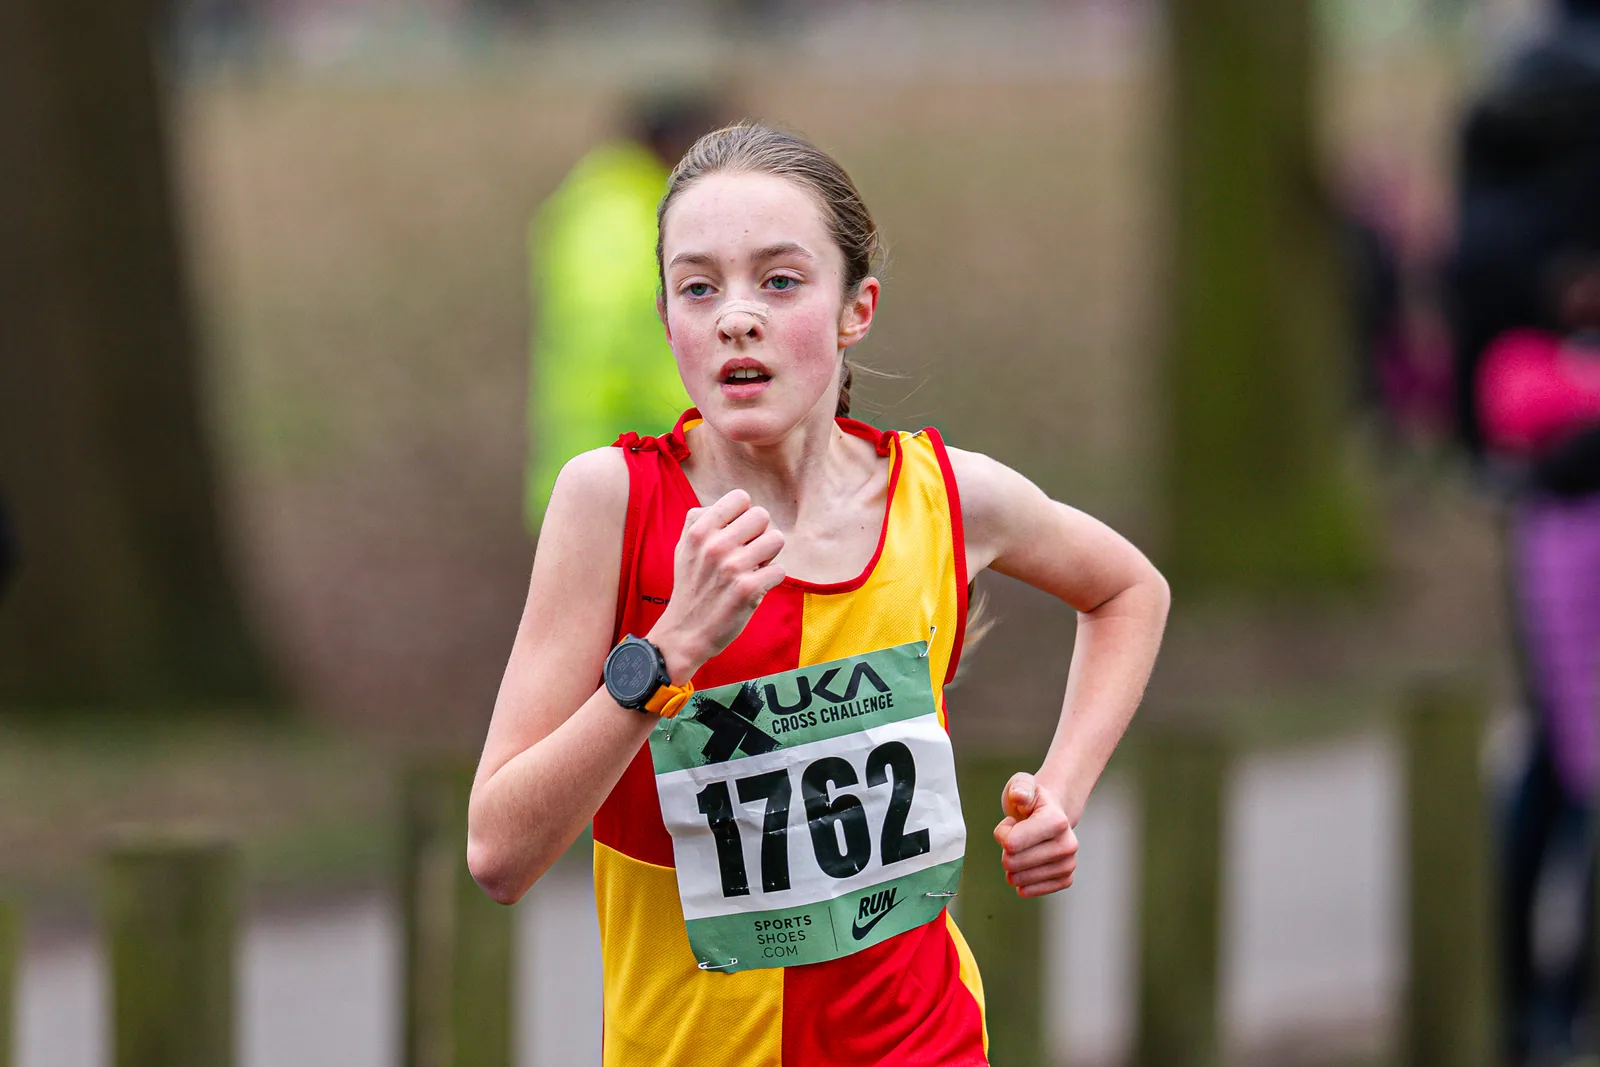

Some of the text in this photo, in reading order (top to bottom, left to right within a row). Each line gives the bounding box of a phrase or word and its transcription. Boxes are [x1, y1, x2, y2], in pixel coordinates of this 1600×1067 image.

[764, 661, 891, 716] UKA
[772, 692, 894, 735] CROSS CHALLENGE
[696, 740, 931, 898] 1762
[858, 887, 898, 920] RUN
[754, 914, 813, 931] SPORTS
[757, 930, 806, 945] SHOES
[760, 945, 799, 959] .COM
